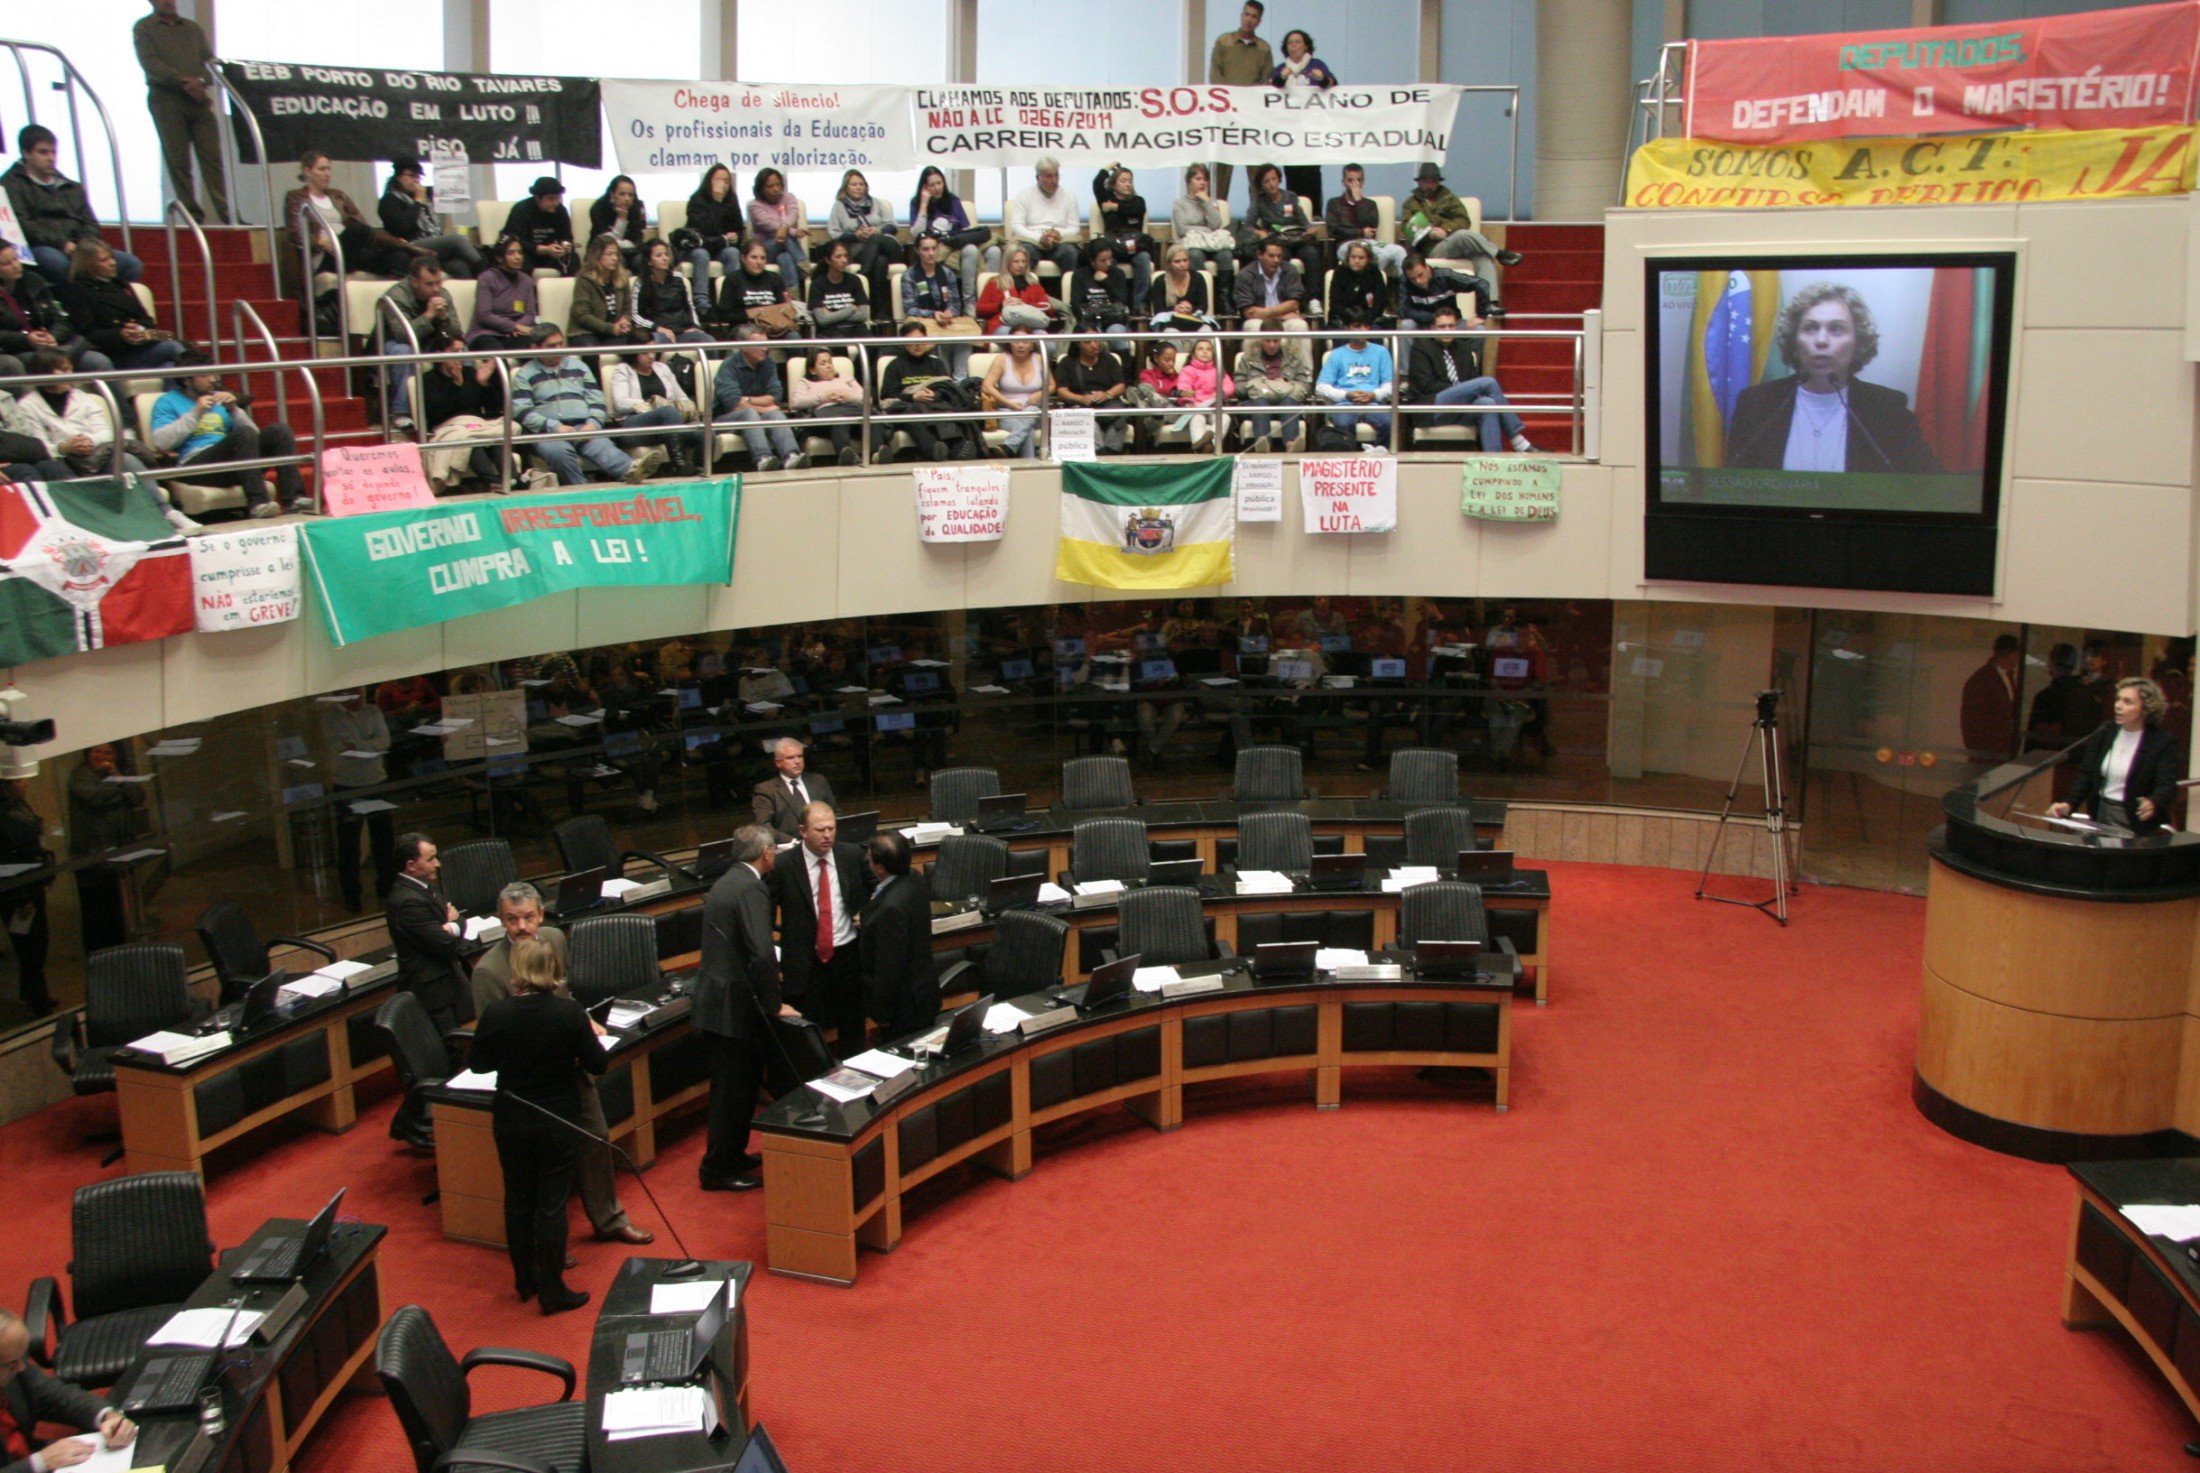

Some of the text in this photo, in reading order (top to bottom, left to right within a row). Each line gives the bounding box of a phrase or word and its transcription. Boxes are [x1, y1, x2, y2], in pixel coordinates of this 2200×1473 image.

[1839, 33, 2028, 71] DEPUTADOS,
[244, 64, 563, 93] EEB PORTO DO RIO TAVARES
[674, 89, 841, 112] Chega de silêncio!
[1010, 91, 1039, 107] AOS
[1045, 91, 1139, 110] DEPUTADOS:
[1140, 88, 1431, 118] S.O.S. PLANO DE
[1733, 66, 2170, 129] DEFENDAM O MAGISTÉRIO!
[270, 95, 389, 120] EDUCAÇÃO
[410, 102, 441, 120] EM
[459, 104, 516, 121] LUTO
[929, 108, 964, 128] NÃO
[986, 107, 1004, 125] LC
[631, 118, 885, 142] Os profissionais da Educação
[926, 122, 1447, 154] CARREIRA MAGISTÉRIO ESTADUAL
[493, 136, 520, 159] JÁ
[650, 146, 872, 169] clamam por valorização.
[1687, 148, 1813, 179] SOMOS
[340, 447, 399, 461] Queremos
[1302, 459, 1383, 479] MAGISTÉRIO
[1508, 464, 1547, 473] ESTAMOS
[918, 483, 949, 501] fiquem
[1314, 481, 1377, 496] PRESENTE
[1472, 478, 1522, 486] CUMPRINDO
[921, 495, 999, 507] estamos lutando
[1470, 490, 1555, 501] LEI DOS HOMENS
[920, 506, 997, 525] por EDUCAÇÃO
[1332, 501, 1349, 513] NA
[1491, 506, 1506, 515] LEI
[1515, 507, 1524, 515] DE
[1528, 505, 1557, 519] DEUS
[925, 521, 1006, 536] de QUALIDADE!
[1320, 515, 1362, 531] LUTA
[200, 535, 286, 555] Se o governo
[364, 512, 482, 561] GOVERNO
[200, 557, 294, 585] cumprisse a lei
[428, 547, 532, 595] CUMPRA
[552, 541, 574, 565] A
[201, 591, 233, 610] NÃO
[223, 597, 298, 622] em GREVE!
